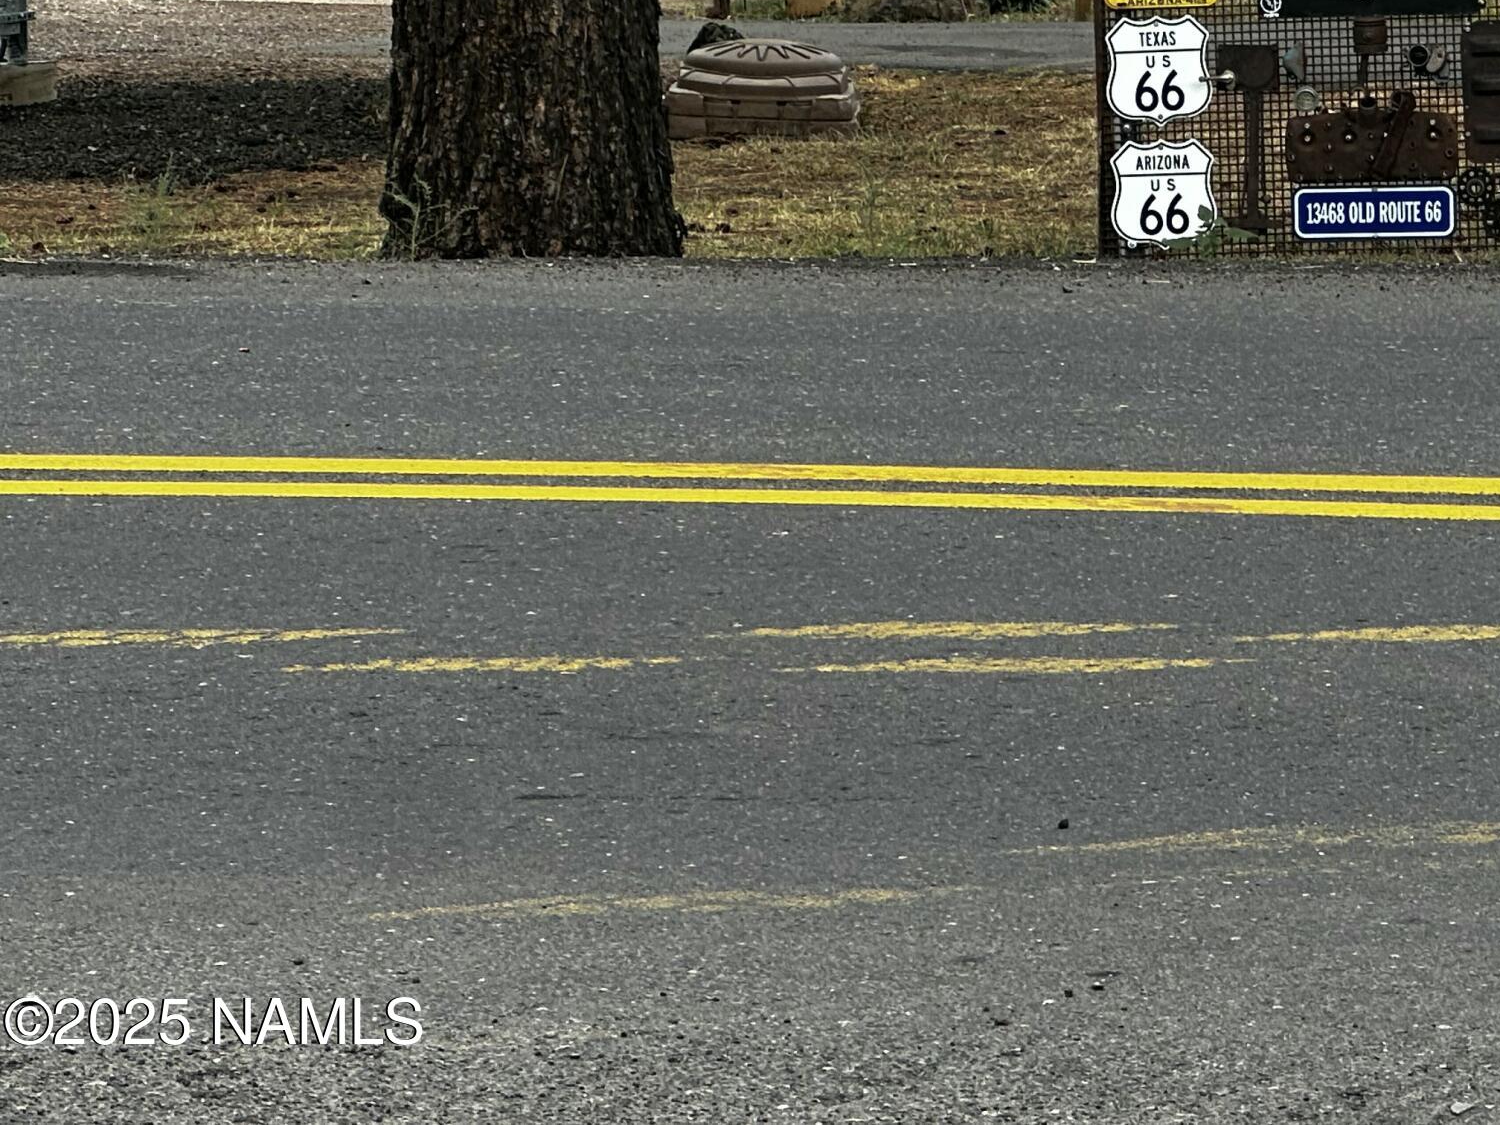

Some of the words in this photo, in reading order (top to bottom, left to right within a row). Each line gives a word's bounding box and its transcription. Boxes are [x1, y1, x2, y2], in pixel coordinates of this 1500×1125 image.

[1138, 31, 1176, 47] TEXAS
[1135, 69, 1185, 112] 66
[1135, 154, 1190, 171] ARIZONA
[1139, 193, 1190, 236] 66
[1306, 202, 1345, 225] 13468
[1348, 201, 1375, 224] OLD
[1379, 200, 1421, 223] ROUTE
[1424, 200, 1442, 223] 66
